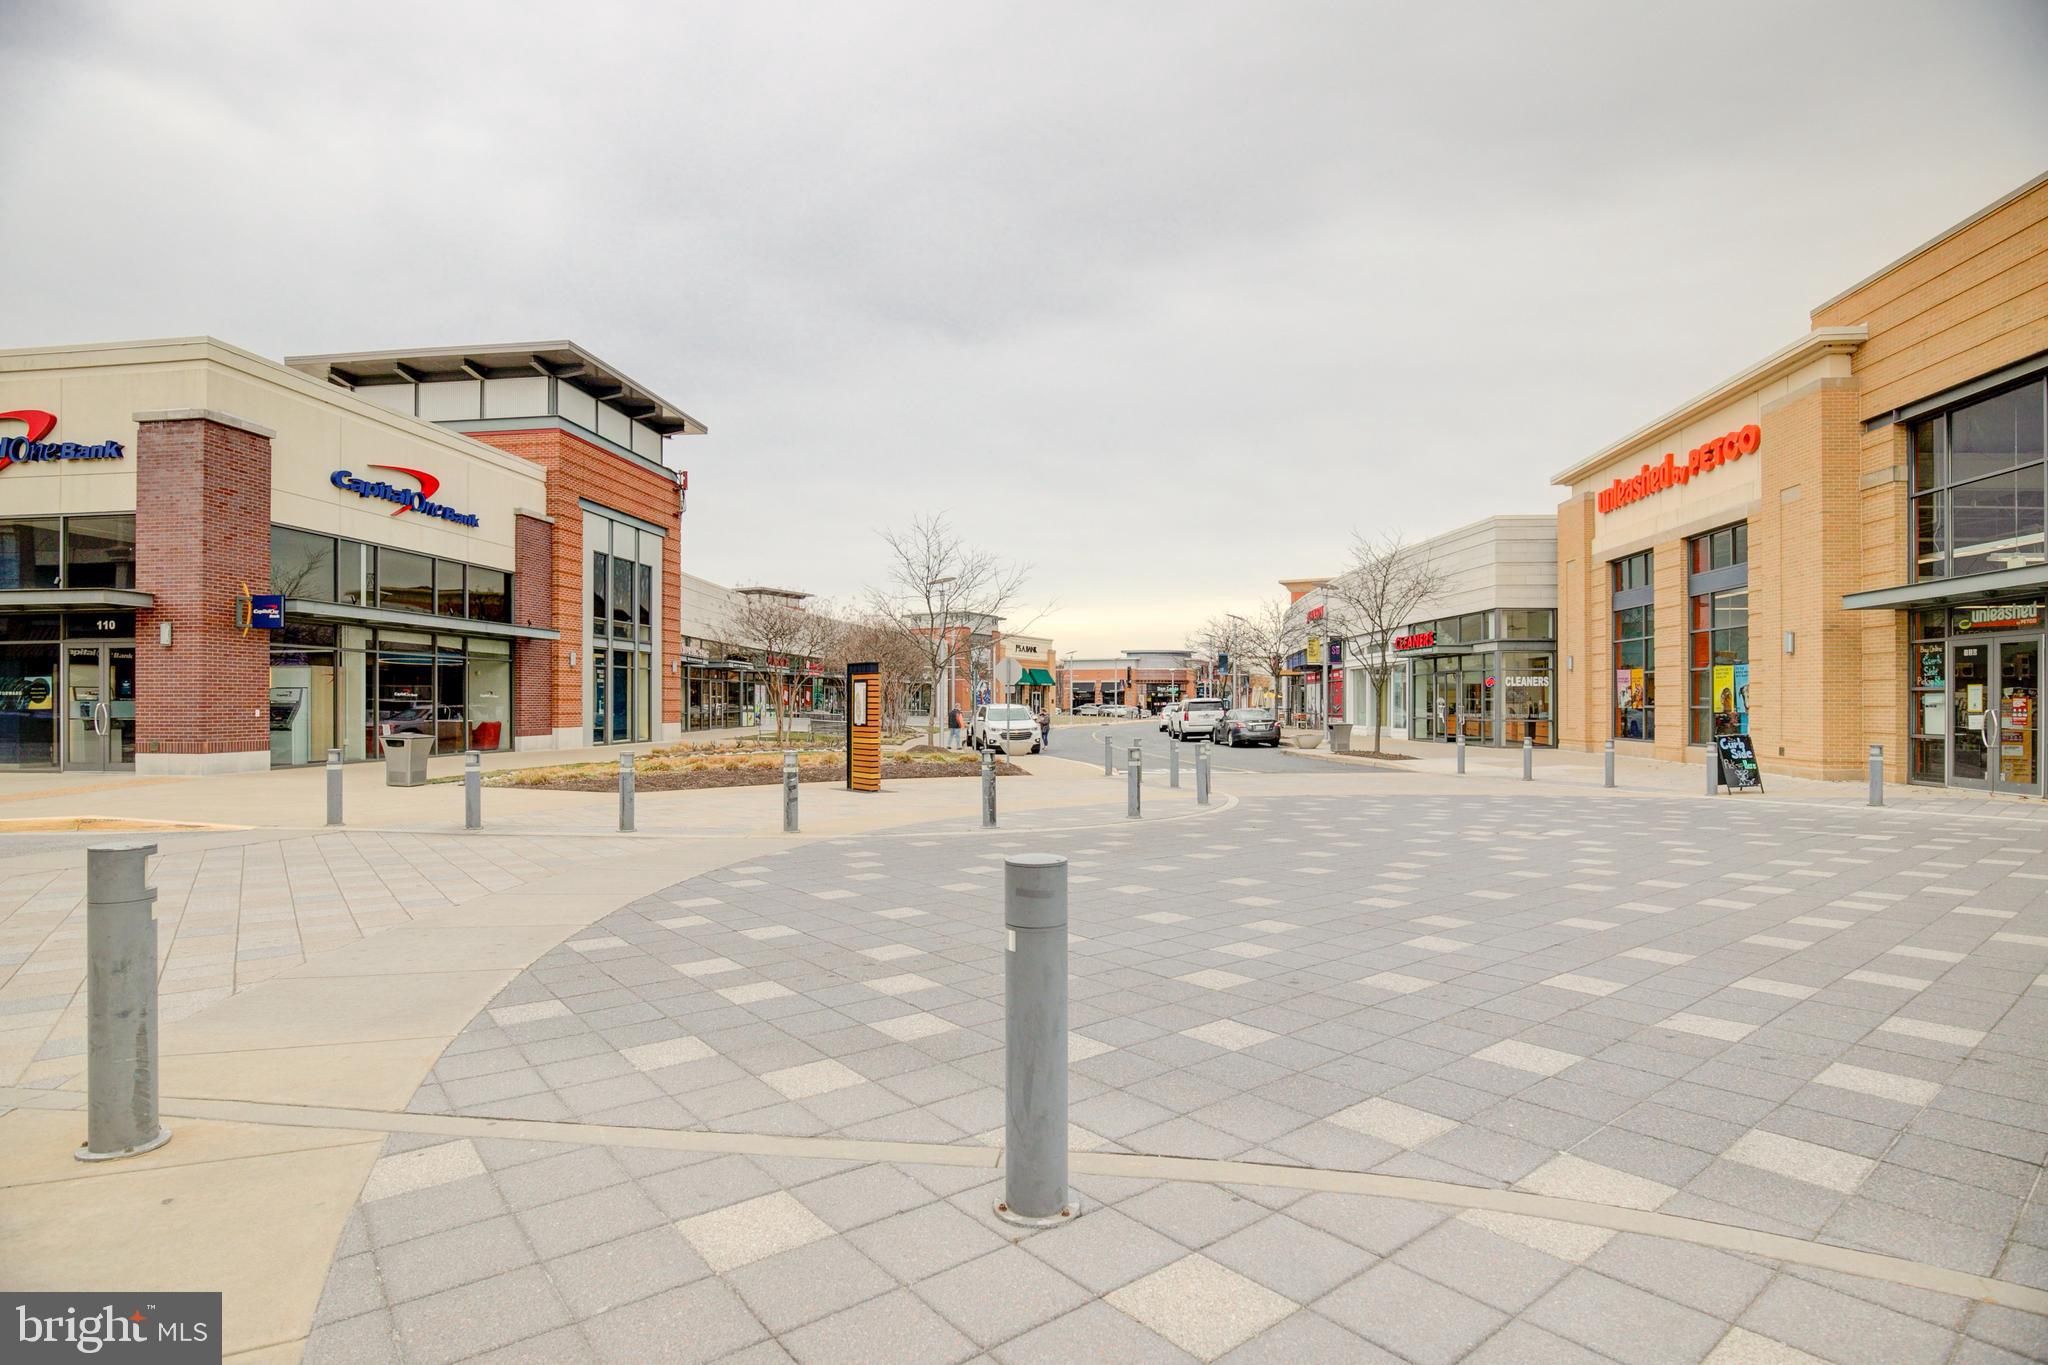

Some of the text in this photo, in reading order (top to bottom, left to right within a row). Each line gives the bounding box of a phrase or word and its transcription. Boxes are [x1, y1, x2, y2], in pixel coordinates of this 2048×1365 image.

[60, 440, 125, 459] Bank
[1598, 424, 1762, 514] unleashed by PETCO
[442, 507, 480, 528] Bank
[1971, 601, 2038, 623] unleashed
[96, 620, 116, 630] 110
[1395, 630, 1435, 651] CLEANERS
[1505, 676, 1549, 686] CLEANERS
[1720, 738, 1745, 750] Curb
[1730, 748, 1753, 759] Side
